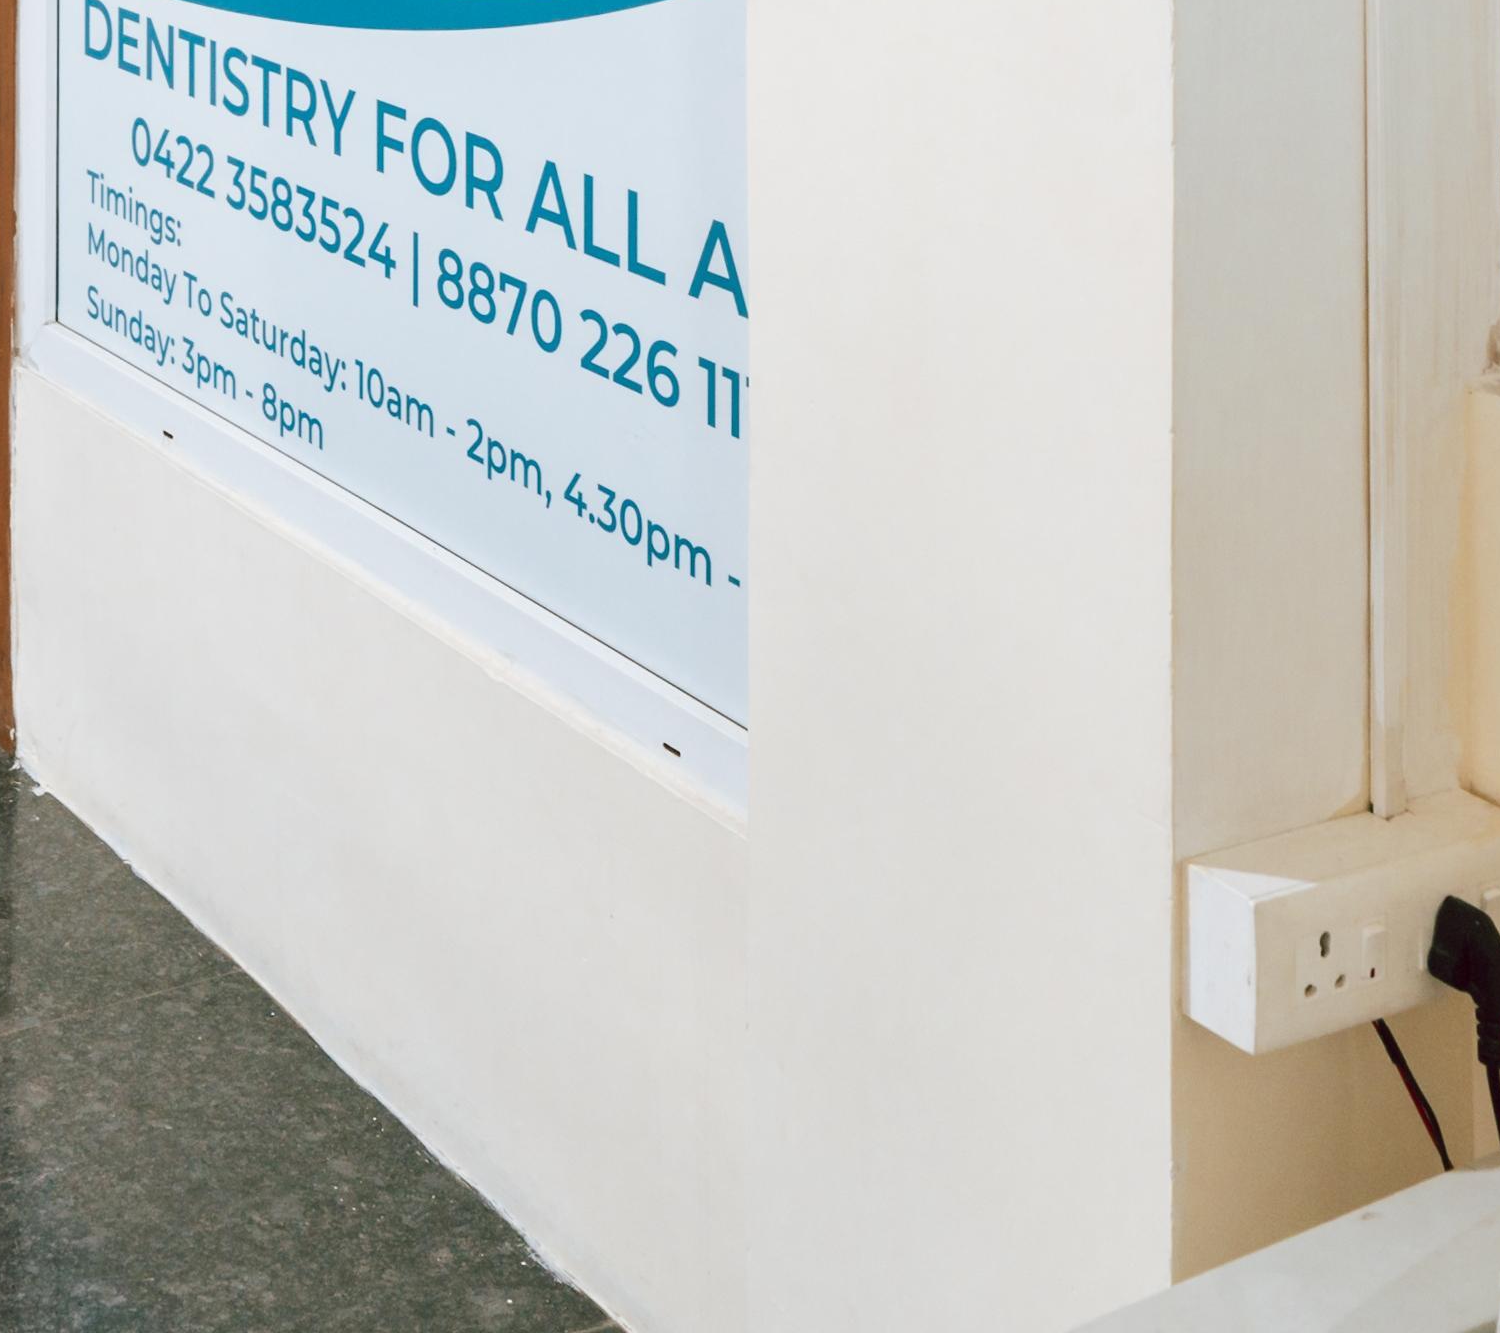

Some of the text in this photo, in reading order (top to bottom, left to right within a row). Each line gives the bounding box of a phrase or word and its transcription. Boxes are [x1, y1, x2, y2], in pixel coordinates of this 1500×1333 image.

[87, 169, 182, 247] Timings:
[131, 116, 217, 199] 0422
[225, 155, 399, 280] 3583524
[435, 246, 564, 355] 8870
[578, 308, 681, 409] 226
[697, 355, 749, 439] 11
[375, 99, 505, 222] FOR
[524, 158, 669, 286] ALL
[87, 284, 176, 368] Sunday:
[181, 336, 238, 400] 3pm
[261, 381, 325, 452] 8pm
[87, 222, 176, 306] Monday
[183, 271, 214, 318] To
[219, 290, 348, 394] Saturday:
[353, 358, 436, 438] 10am
[465, 416, 553, 508] 2pm,
[562, 470, 713, 587] 4.30pm
